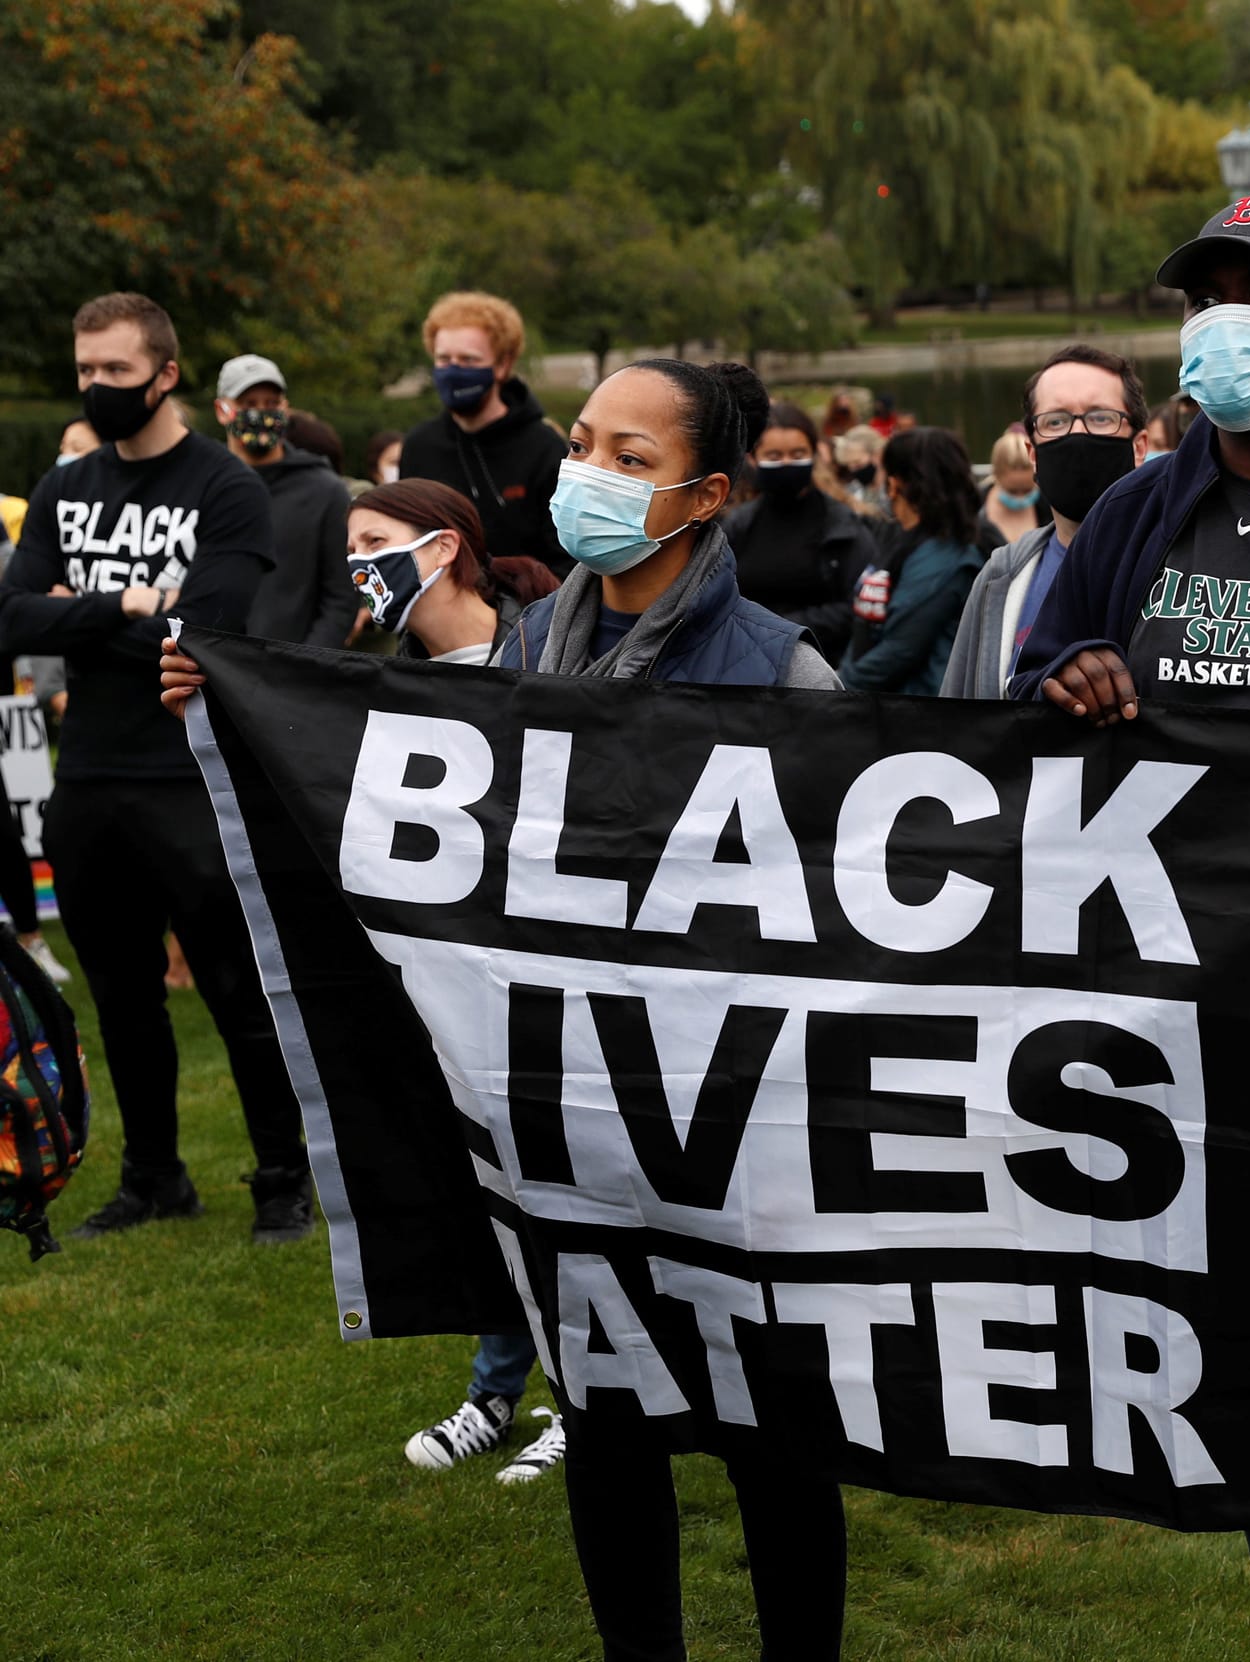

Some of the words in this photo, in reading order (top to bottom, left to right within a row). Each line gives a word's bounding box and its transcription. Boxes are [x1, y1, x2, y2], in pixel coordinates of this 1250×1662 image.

[57, 500, 199, 562] BLACK
[67, 558, 150, 593] IVES
[339, 709, 1210, 966] BLACK
[470, 981, 1186, 1222] IVES
